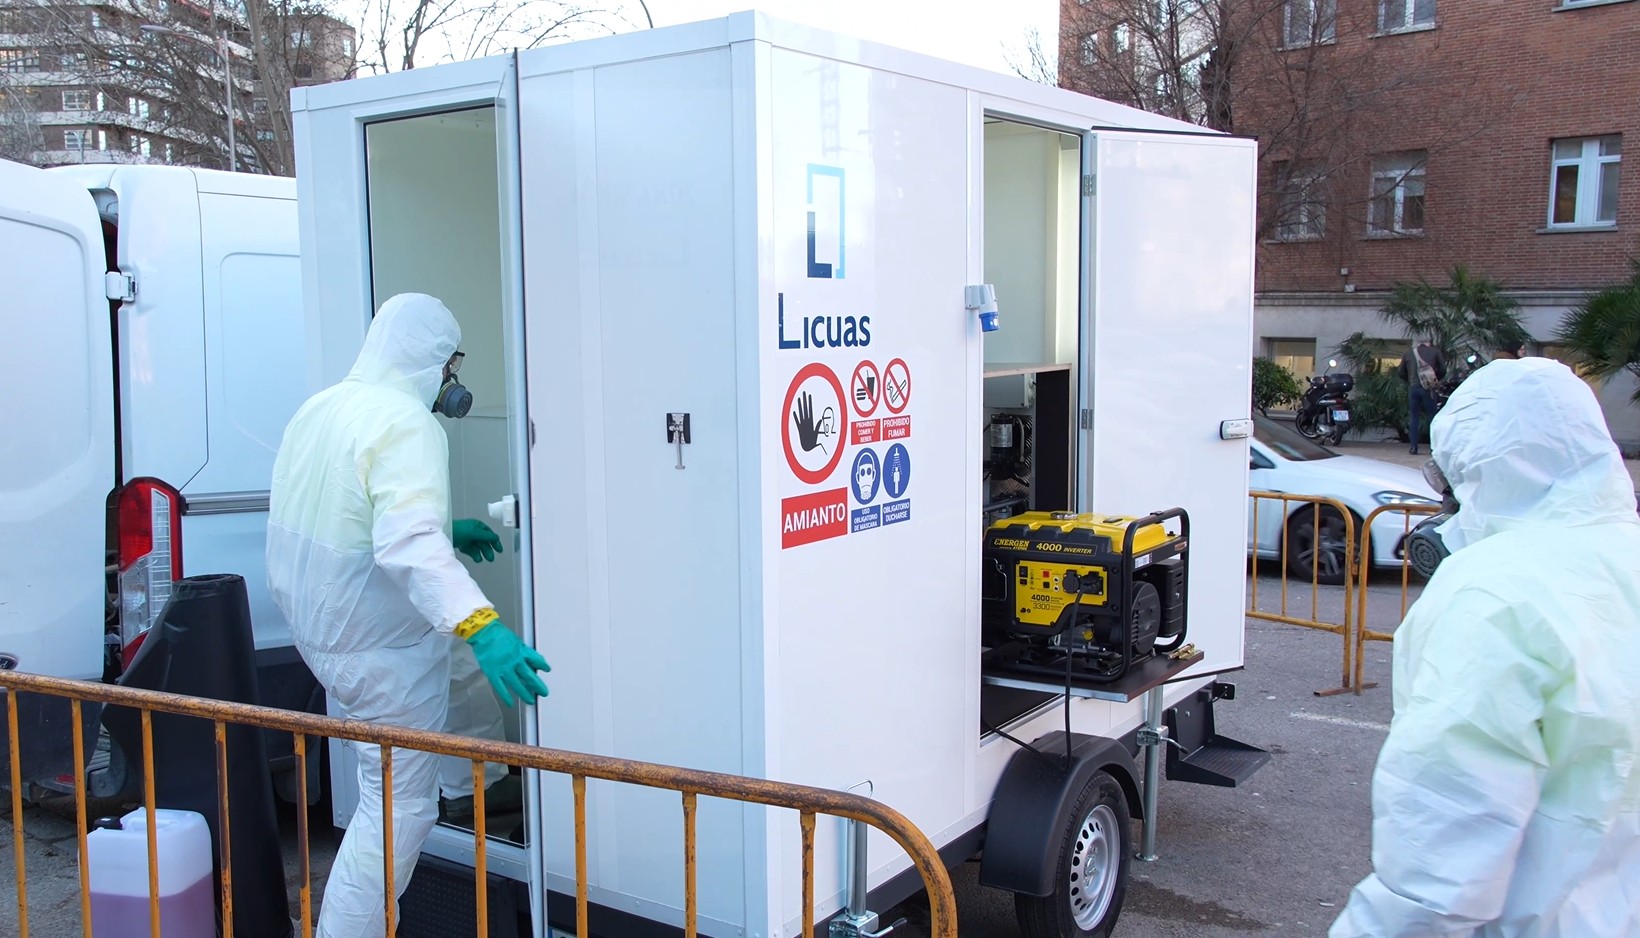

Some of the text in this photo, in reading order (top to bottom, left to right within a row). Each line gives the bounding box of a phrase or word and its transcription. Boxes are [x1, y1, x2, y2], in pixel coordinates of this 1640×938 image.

[778, 293, 871, 350] Licuas
[856, 420, 876, 428] PROHIBIDO
[884, 417, 910, 428] PROHIBIDO
[857, 428, 870, 436] COMER
[888, 428, 905, 438] FUMAR
[883, 502, 909, 514] OBLIGATORIO
[783, 502, 846, 534] AMIANTO
[854, 513, 878, 524] OBLIGATORIO
[885, 511, 908, 522] DUCHARSE
[854, 524, 859, 532] DE
[994, 538, 1030, 548] ENERGEN
[1036, 543, 1062, 552] 4000
[1031, 594, 1050, 602] 4000
[1032, 602, 1051, 611] 3300
